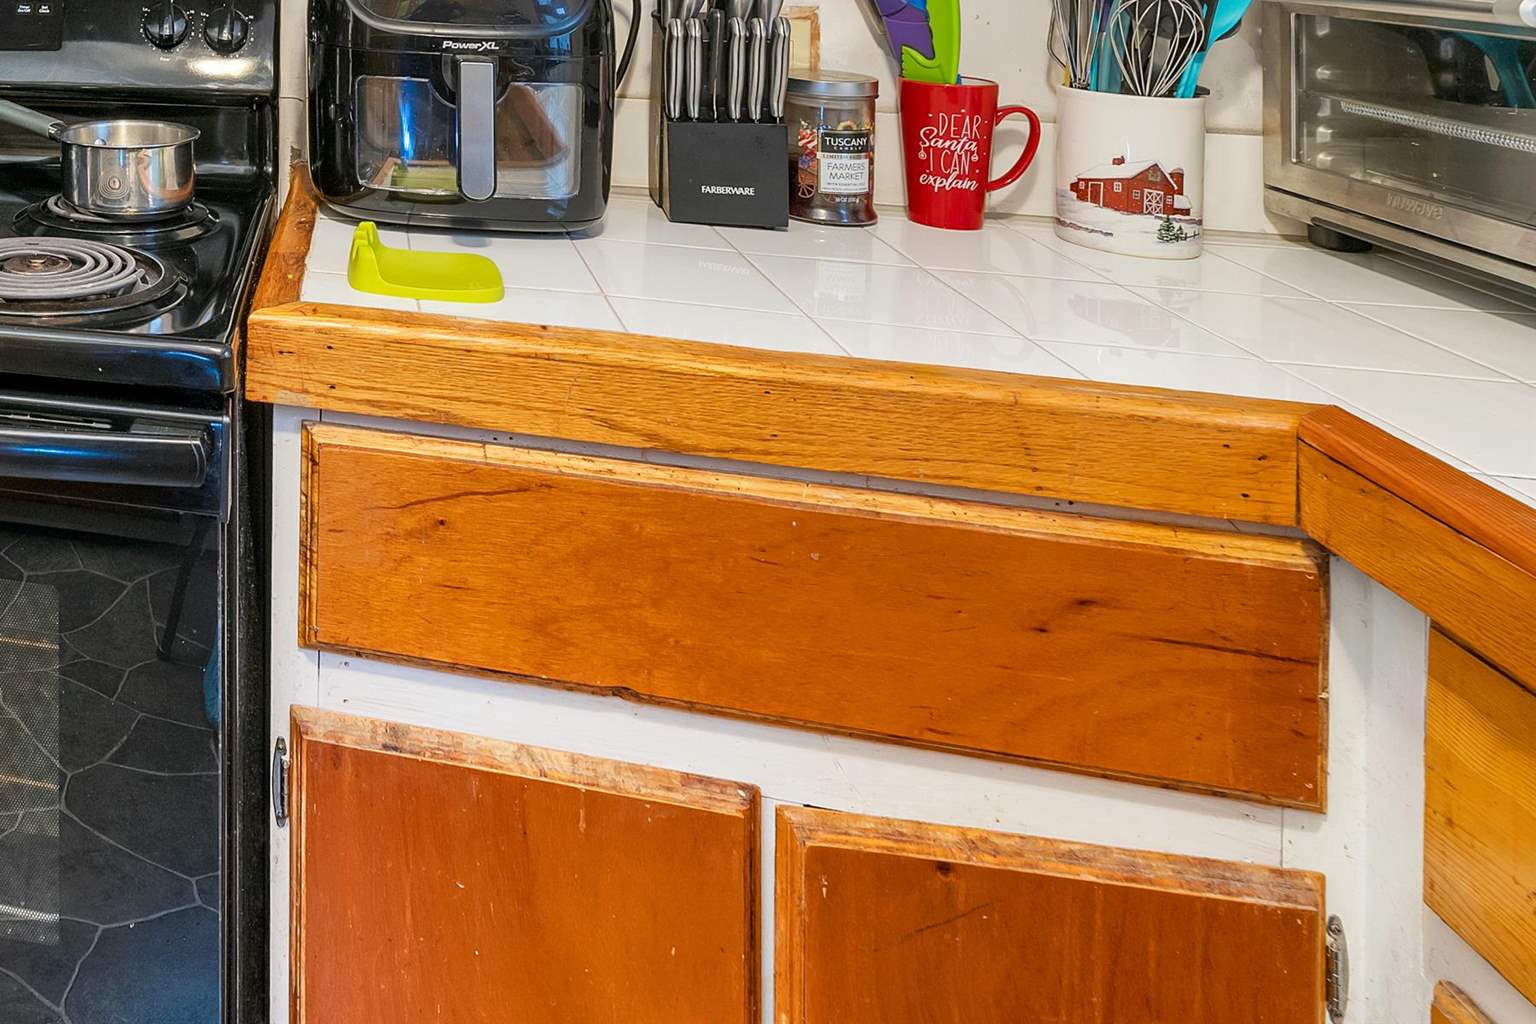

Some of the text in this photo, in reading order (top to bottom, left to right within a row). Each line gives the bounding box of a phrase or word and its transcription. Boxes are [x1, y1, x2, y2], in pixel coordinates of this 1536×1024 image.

[442, 40, 499, 52] PowerXL
[939, 112, 982, 139] DEAR
[825, 137, 868, 146] TUSCANY
[919, 126, 978, 154] Santa
[827, 162, 866, 171] FARMERS
[940, 149, 970, 174] CAN
[829, 172, 865, 181] MARKET
[919, 171, 978, 193] explain
[701, 185, 755, 196] FARBERWARE
